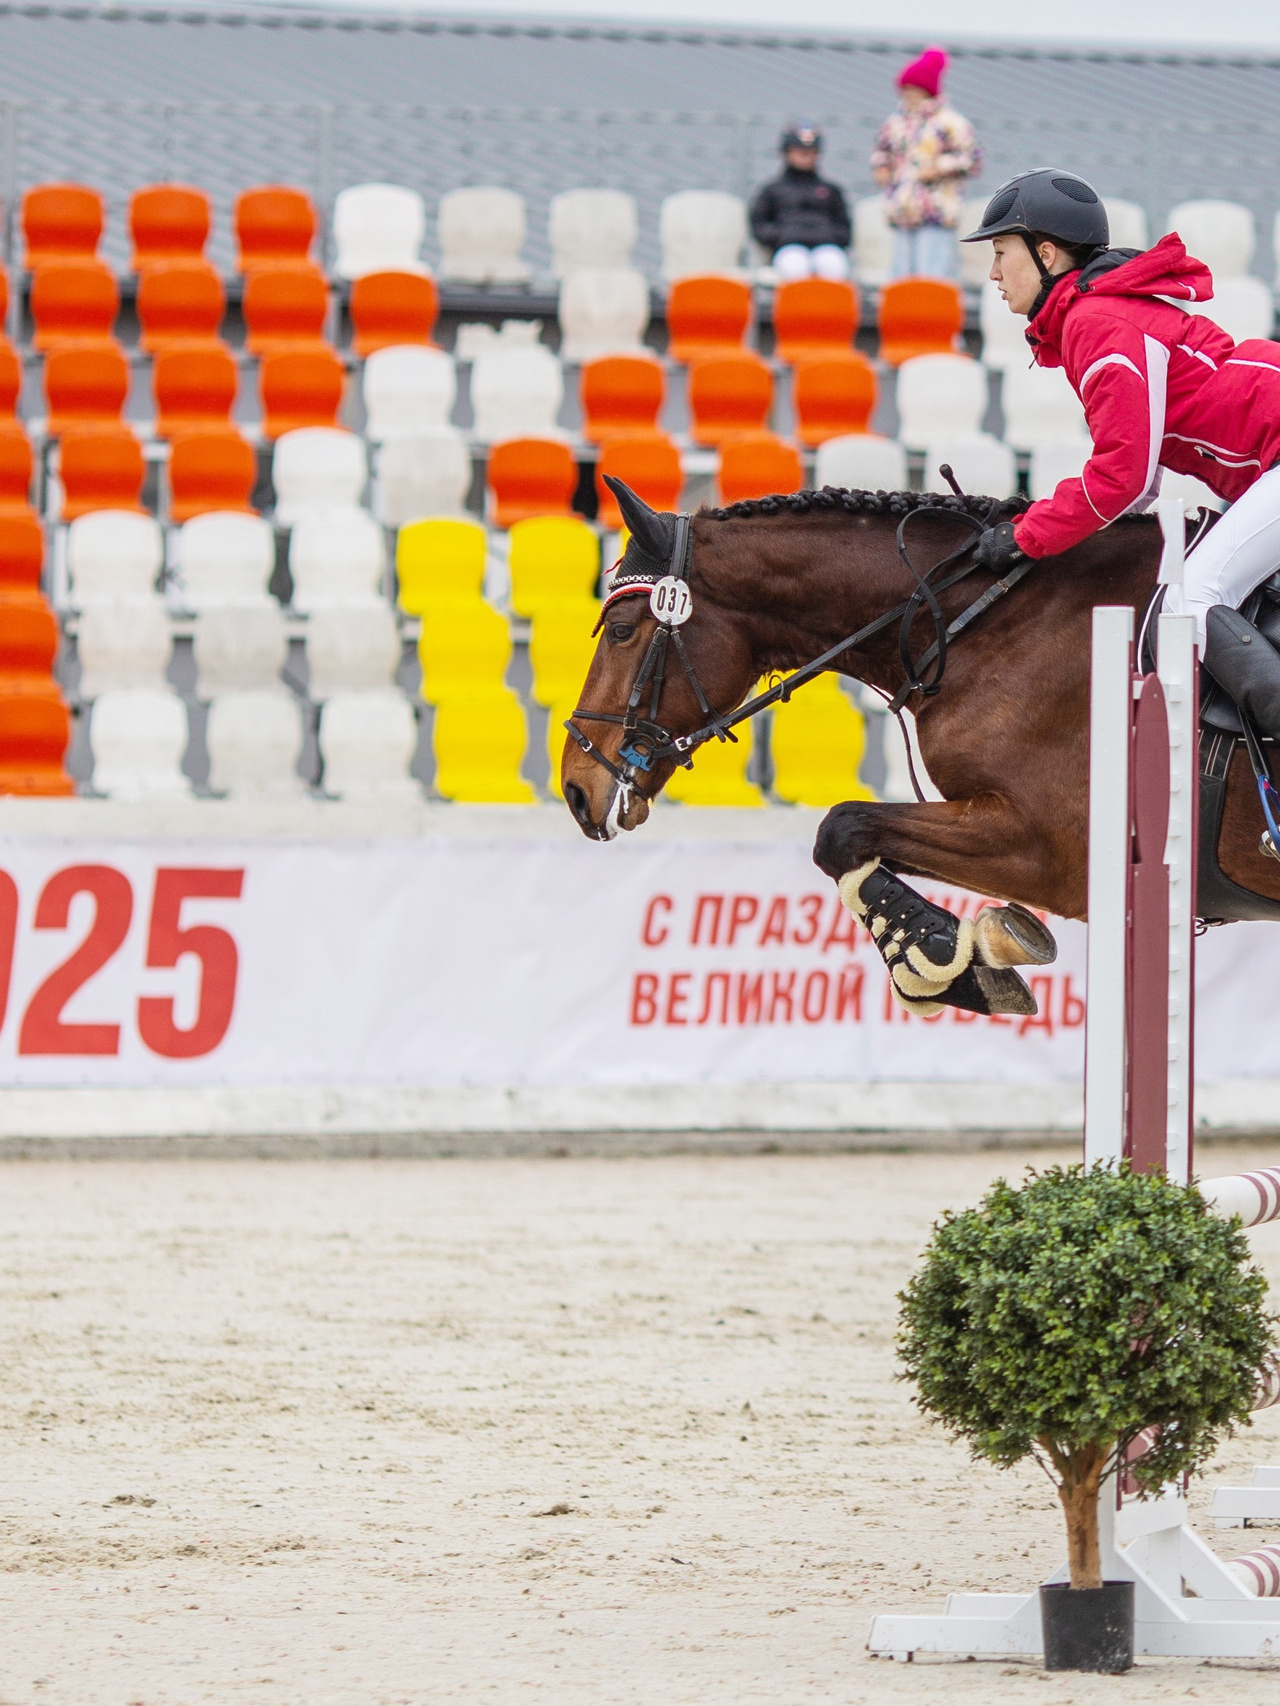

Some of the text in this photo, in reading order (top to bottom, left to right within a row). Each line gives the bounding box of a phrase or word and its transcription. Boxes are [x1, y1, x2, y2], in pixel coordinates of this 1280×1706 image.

[656, 585, 688, 615] 037
[641, 893, 1047, 955] С ПРАЗД
[0, 862, 245, 1060] 25
[628, 963, 867, 1027] ВЕЛИКОЙ
